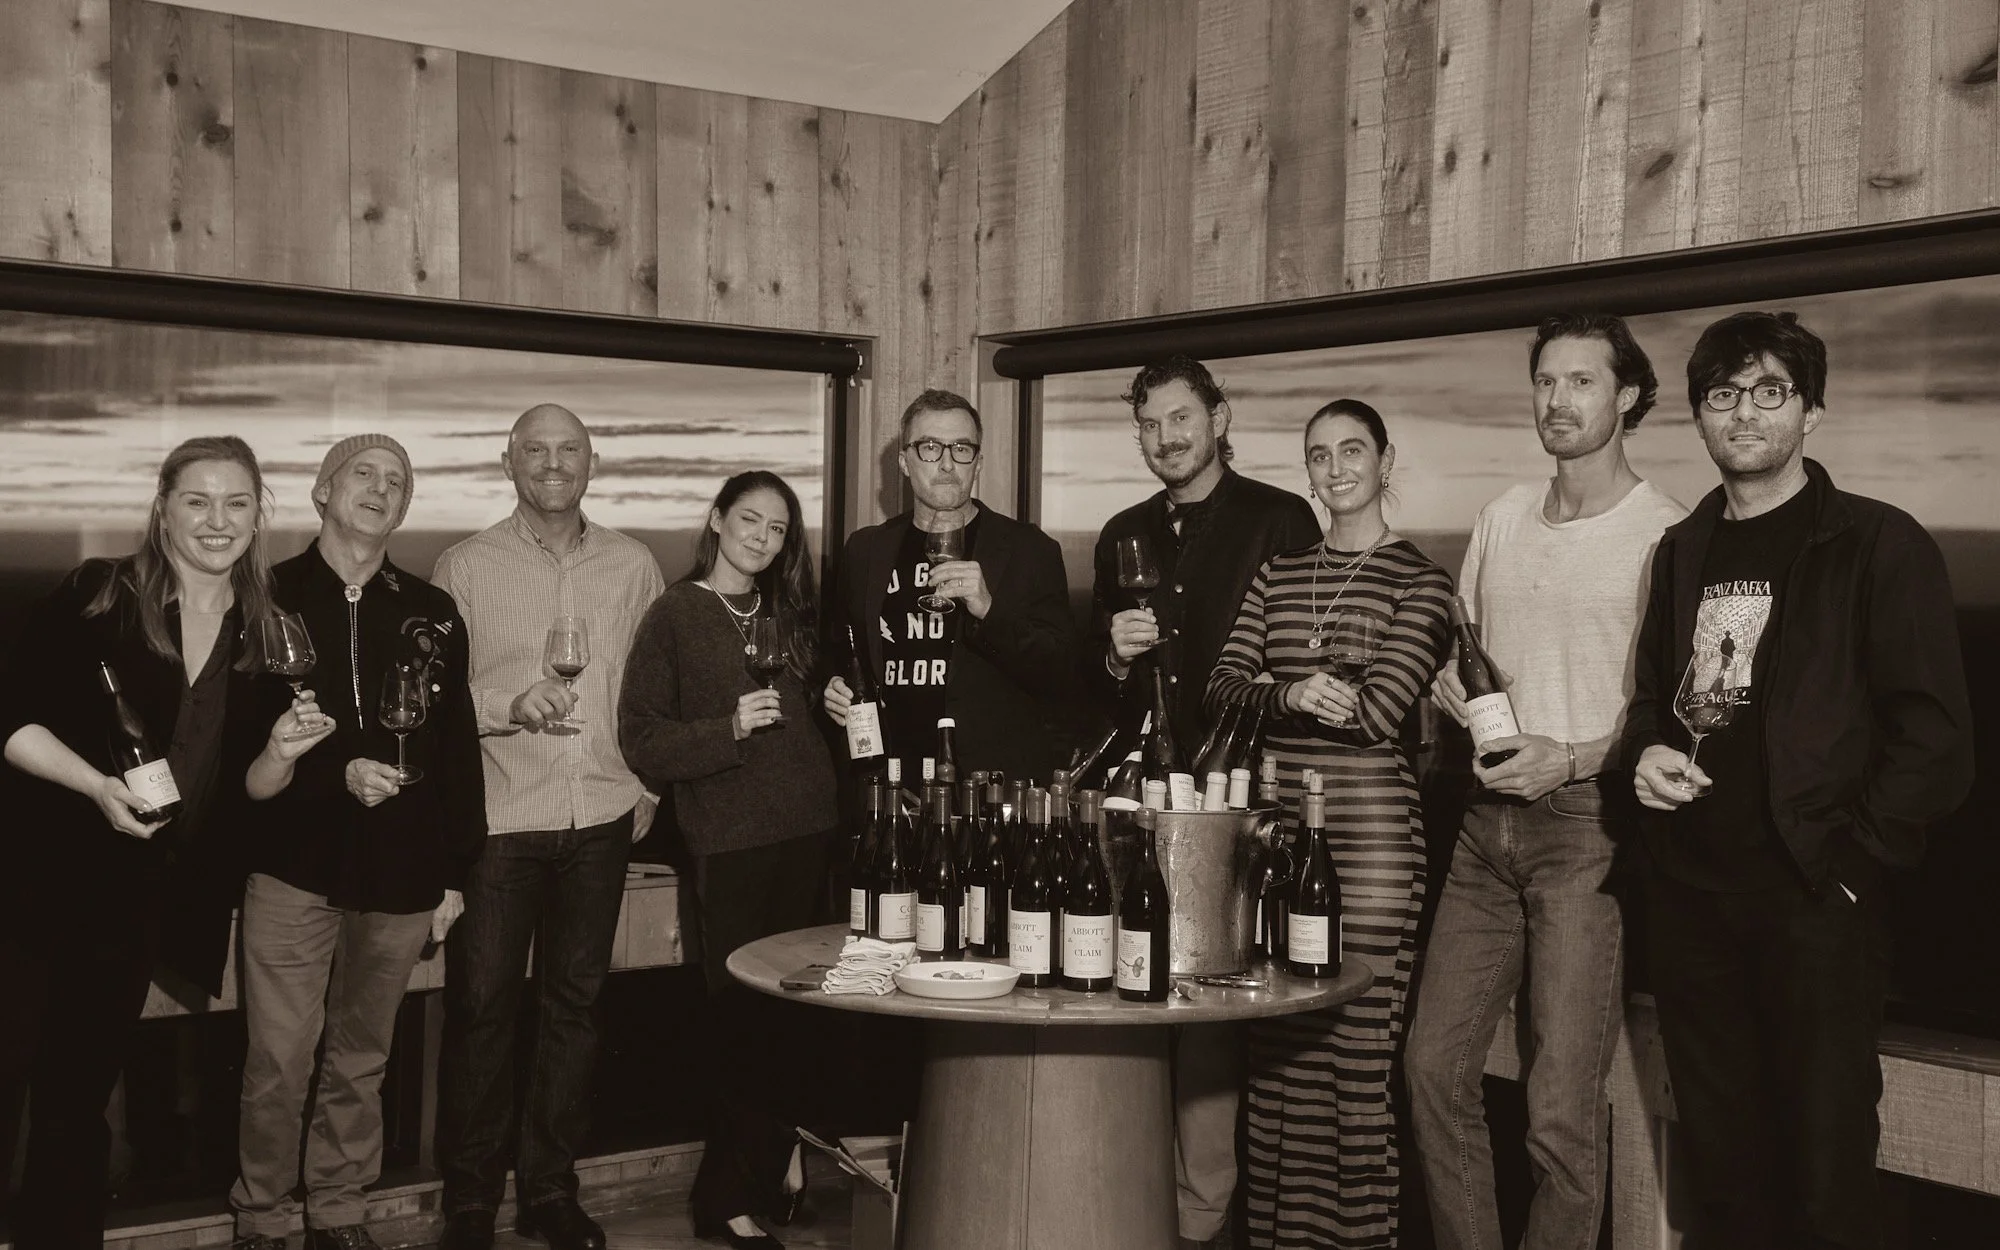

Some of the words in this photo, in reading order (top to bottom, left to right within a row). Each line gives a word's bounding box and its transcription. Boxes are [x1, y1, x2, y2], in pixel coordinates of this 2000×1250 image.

[1732, 580, 1772, 596] KAFKA
[906, 612, 944, 640] NO
[884, 659, 947, 686] GLOR
[1477, 722, 1503, 735] CLAIM
[1071, 927, 1105, 936] ABBOTT
[1074, 949, 1102, 957] CLAIM
